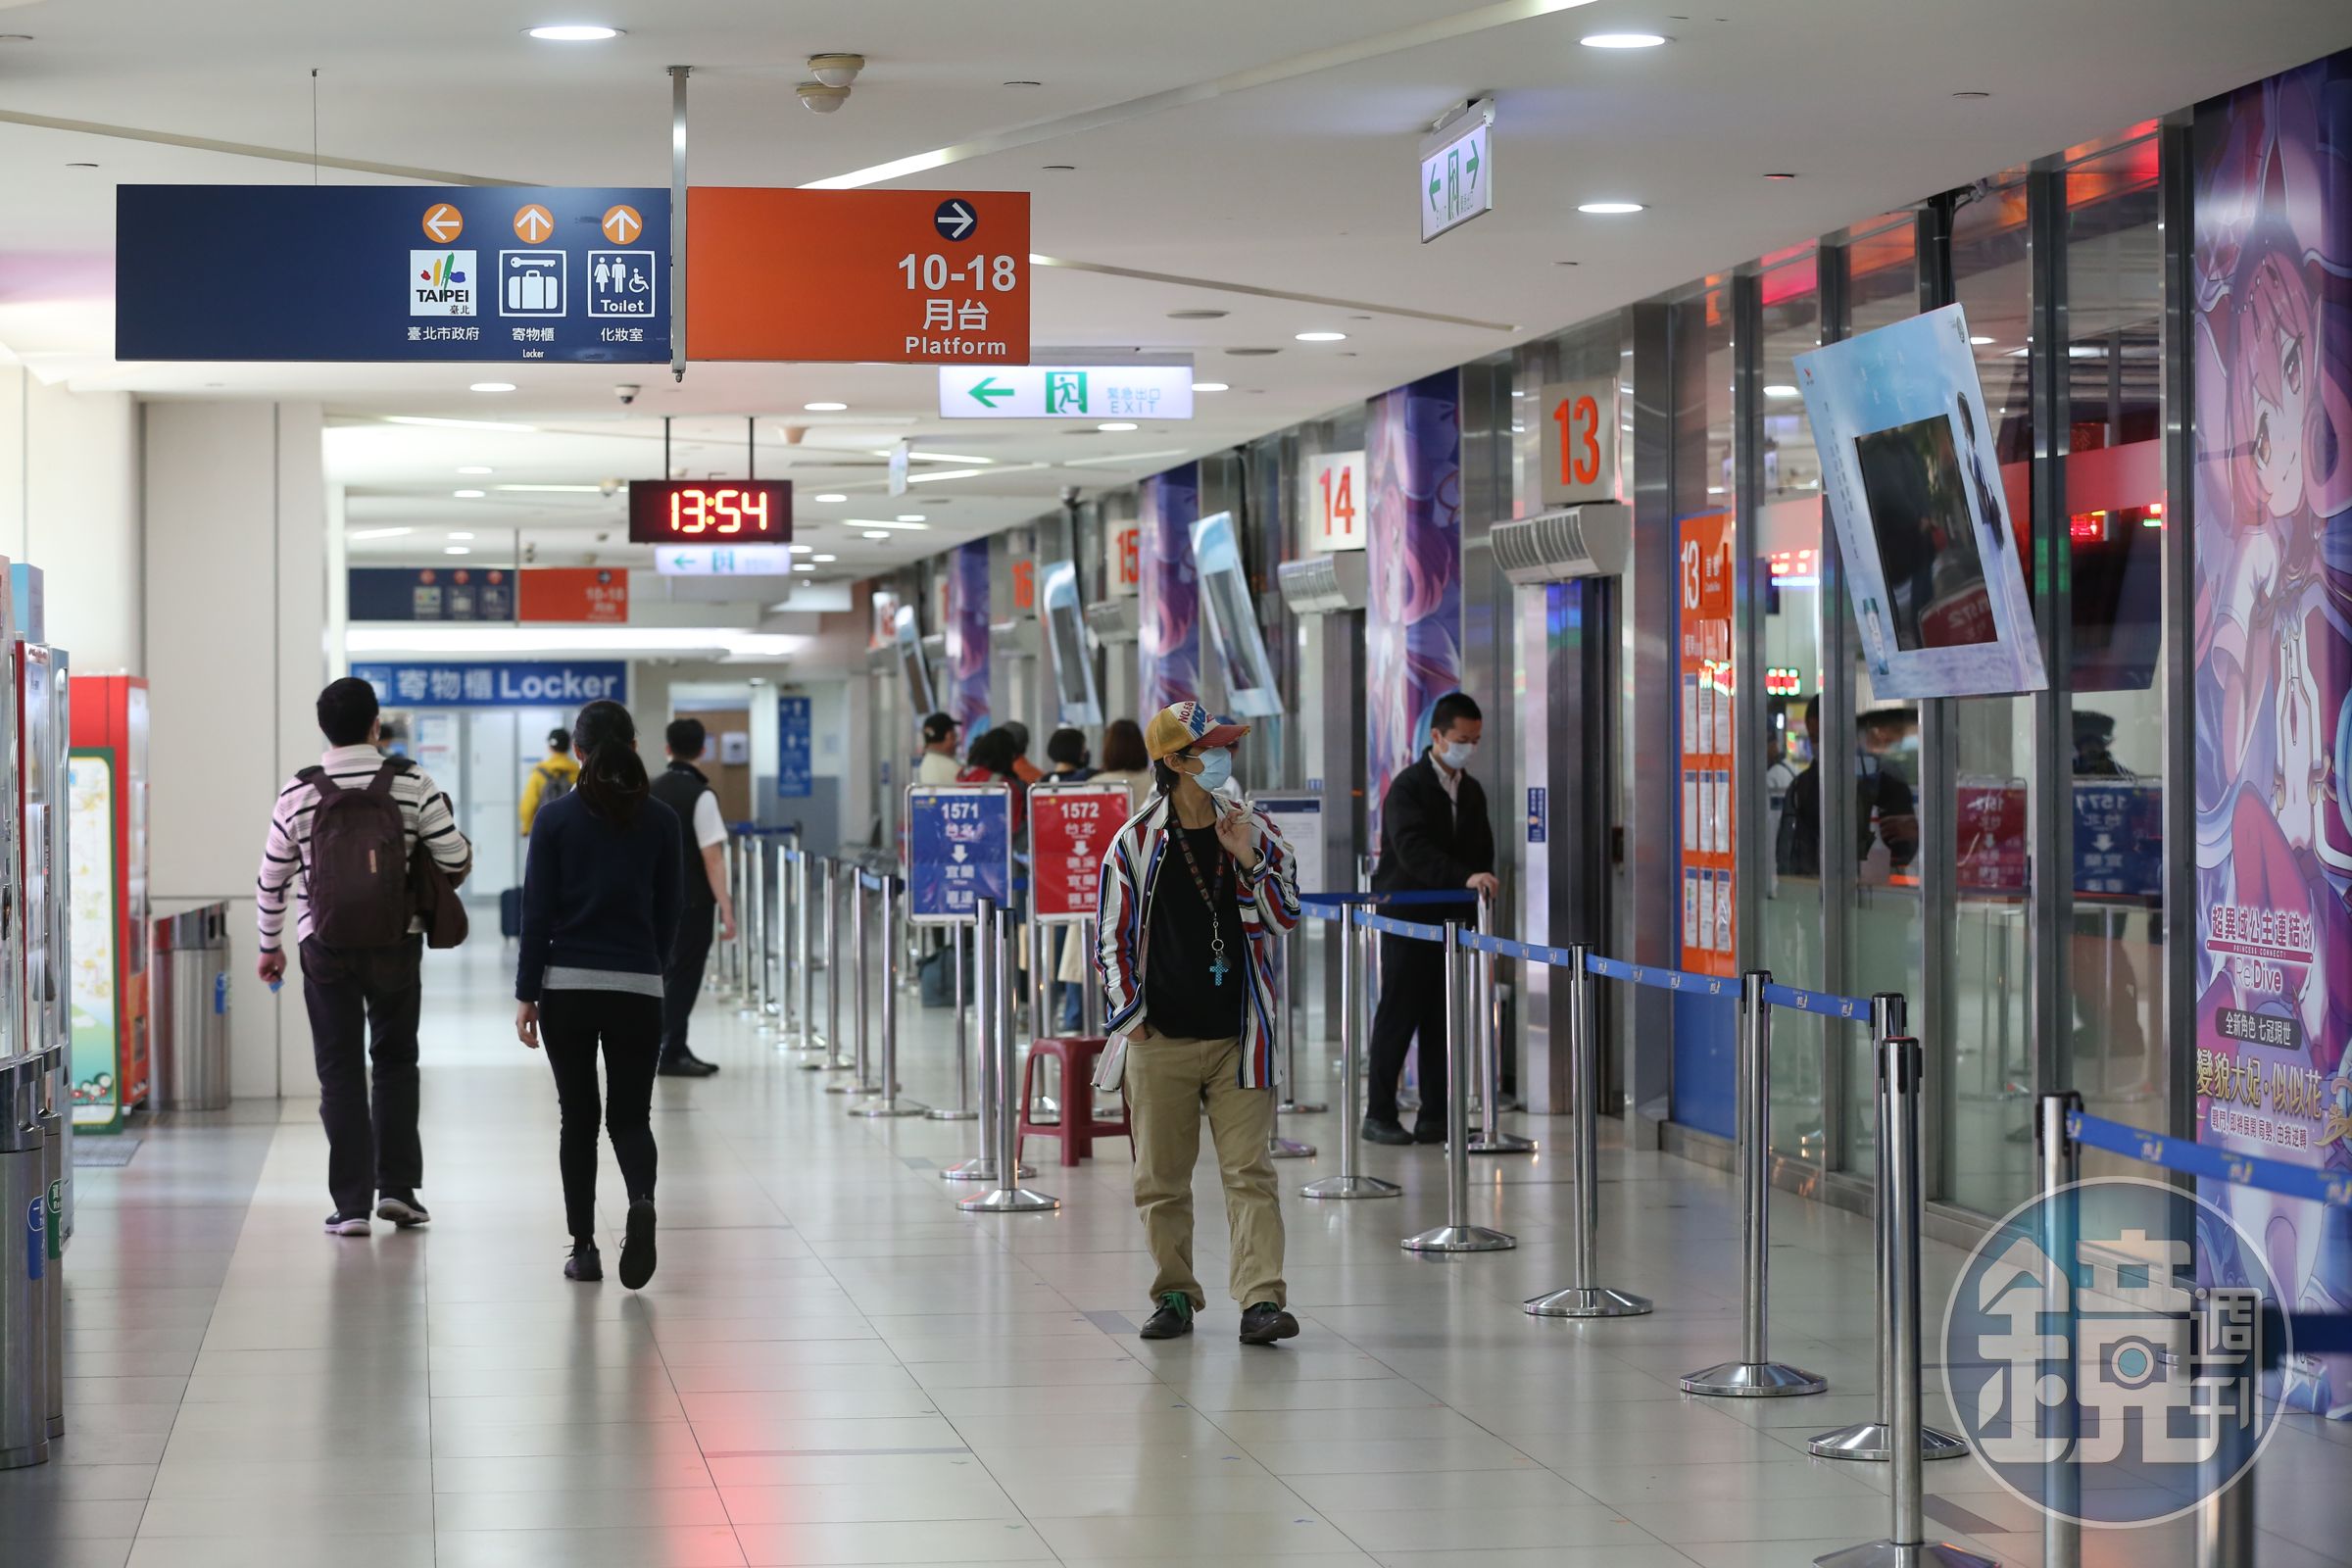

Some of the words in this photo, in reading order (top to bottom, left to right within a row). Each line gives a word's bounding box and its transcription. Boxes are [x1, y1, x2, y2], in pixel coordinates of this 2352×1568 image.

[898, 252, 1017, 292] 10-18
[416, 289, 469, 303] TAIPEI
[601, 299, 644, 313] Toilet
[449, 305, 470, 315] 臺北
[922, 298, 990, 331] 月台
[407, 325, 480, 341] 臺北市政府
[512, 326, 555, 342] 寄物櫃
[601, 327, 644, 342] 化妝室
[522, 349, 545, 359] Locker
[905, 336, 1007, 356] Platform
[1110, 400, 1156, 414] EXIT
[1553, 395, 1599, 486] 13
[670, 489, 767, 533] 13:54
[1318, 466, 1355, 536] 14
[1116, 529, 1139, 584] 15
[1681, 540, 1699, 610] 13
[396, 669, 493, 700] 寄物櫃
[500, 670, 617, 698] Locker
[941, 802, 979, 819] 1571
[1060, 802, 1100, 819] 1572
[2212, 906, 2300, 949] 超異域公主連結
[2225, 1011, 2257, 1040] 全新角色
[2258, 1017, 2291, 1047] 七冠現世
